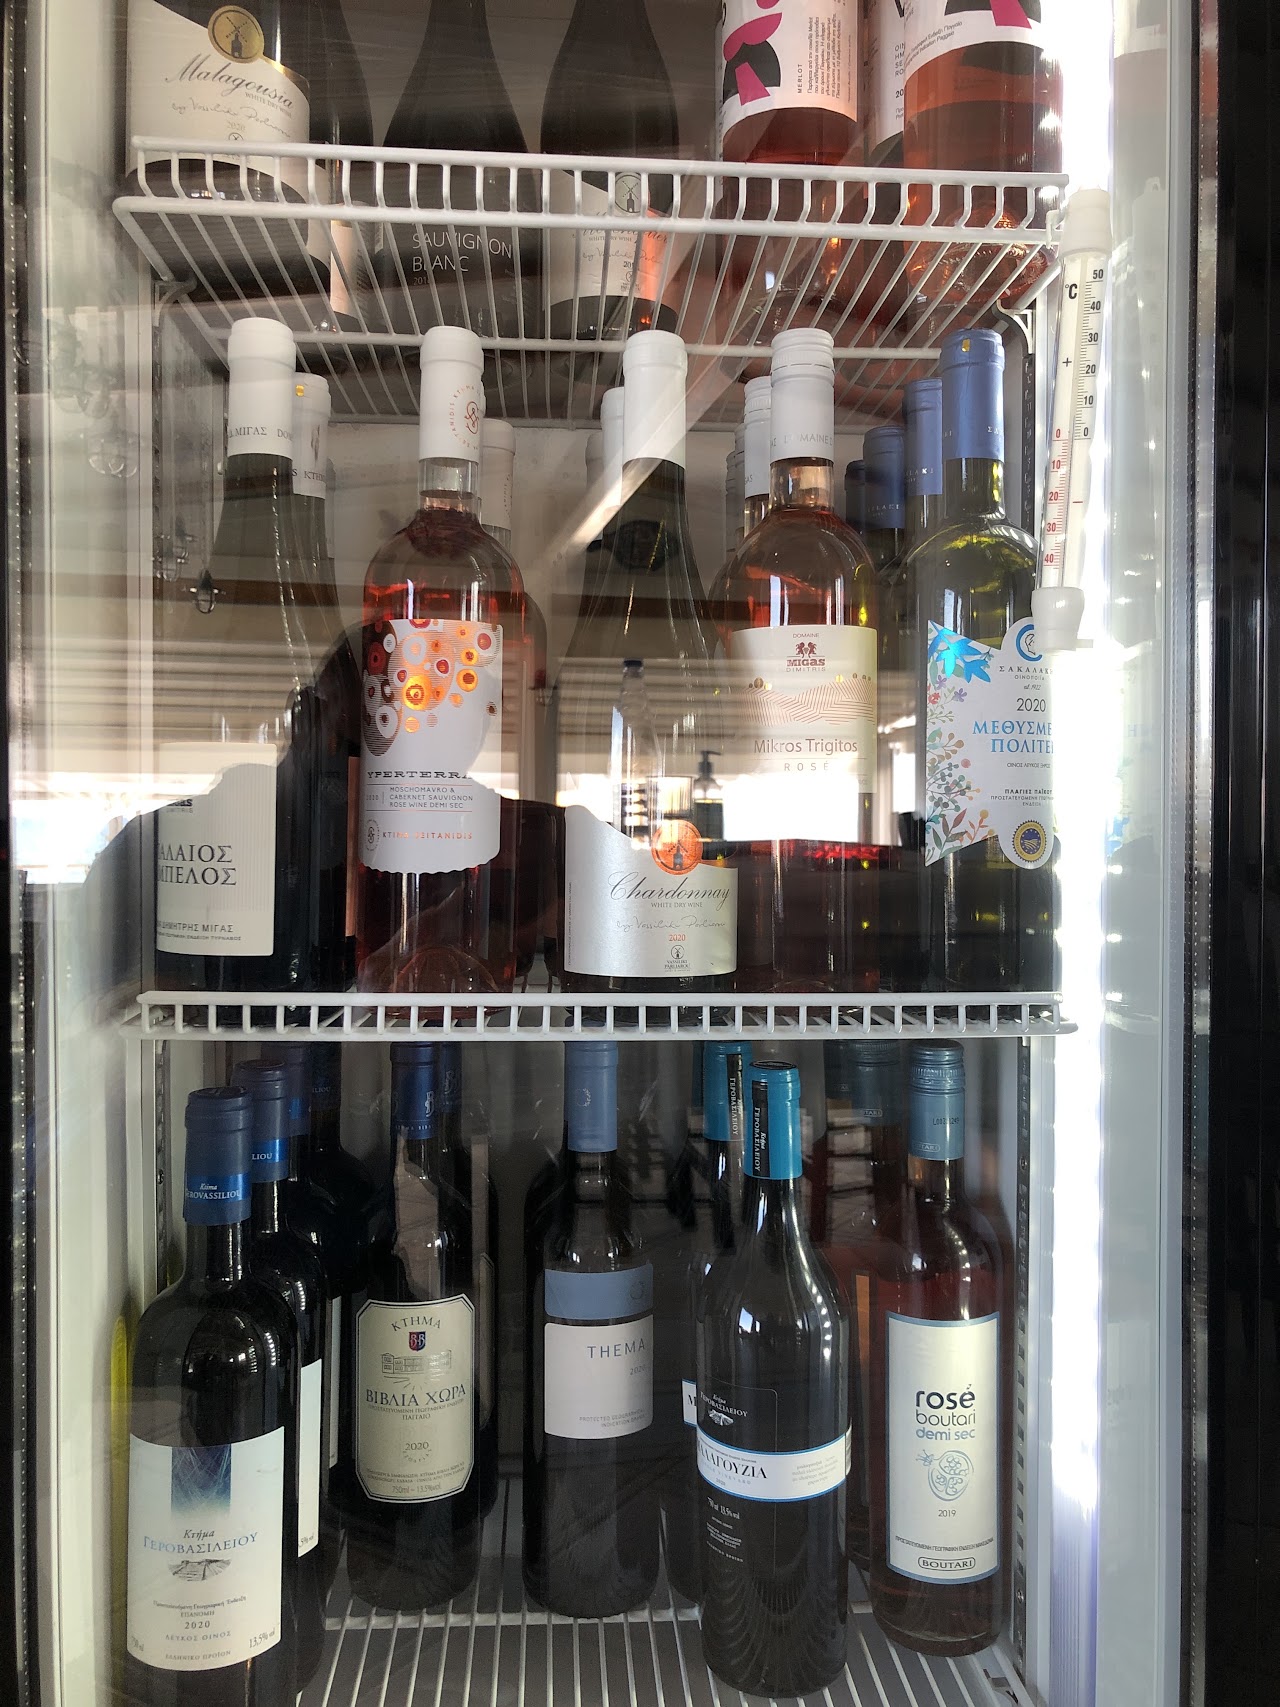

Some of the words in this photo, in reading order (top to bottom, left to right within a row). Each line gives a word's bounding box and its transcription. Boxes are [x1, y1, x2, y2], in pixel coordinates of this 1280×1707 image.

[1092, 269, 1104, 280] 50
[1089, 300, 1102, 311] 40
[1087, 332, 1099, 343] 30
[1085, 365, 1096, 375] 20
[1083, 396, 1094, 406] 10
[1055, 428, 1061, 438] 0
[1083, 427, 1089, 437] 0
[1051, 459, 1062, 470] 10
[1048, 491, 1059, 502] 20
[1046, 522, 1057, 533] 30
[1043, 553, 1055, 564] 40
[1016, 697, 1047, 713] 2020
[753, 738, 802, 754] Mikros
[805, 738, 858, 756] Trigitos
[389, 786, 448, 794] MOSCHOMAVRO
[428, 794, 474, 802] SAUVIGNON
[608, 871, 730, 911] Chardonnay
[202, 924, 234, 933] ΜΙΓΑΣ
[668, 933, 686, 942] 2020
[391, 1315, 441, 1332] ΚΤΗΜΑ
[587, 1338, 645, 1359] THEMA
[365, 1388, 420, 1407] ΒΙΒΛΙΑ
[425, 1383, 466, 1406] ΧΩΡΑ
[915, 1383, 976, 1410] rosé
[915, 1409, 976, 1427] boutari
[915, 1427, 951, 1441] demi
[954, 1428, 976, 1441] sec
[404, 1441, 430, 1452] 2020
[937, 1509, 957, 1518] 2019
[143, 1532, 259, 1554] ΓΕΡΟΒΑΣΙΛΕΙΟΥ
[922, 1559, 973, 1569] BOUTARI
[180, 1610, 215, 1618] ΕΠΑΝΟΜΗ
[184, 1620, 211, 1630] 2020
[165, 1633, 198, 1642] ΛΕΥΚΟΣ
[201, 1630, 231, 1641] ΟΙΝΟΣ
